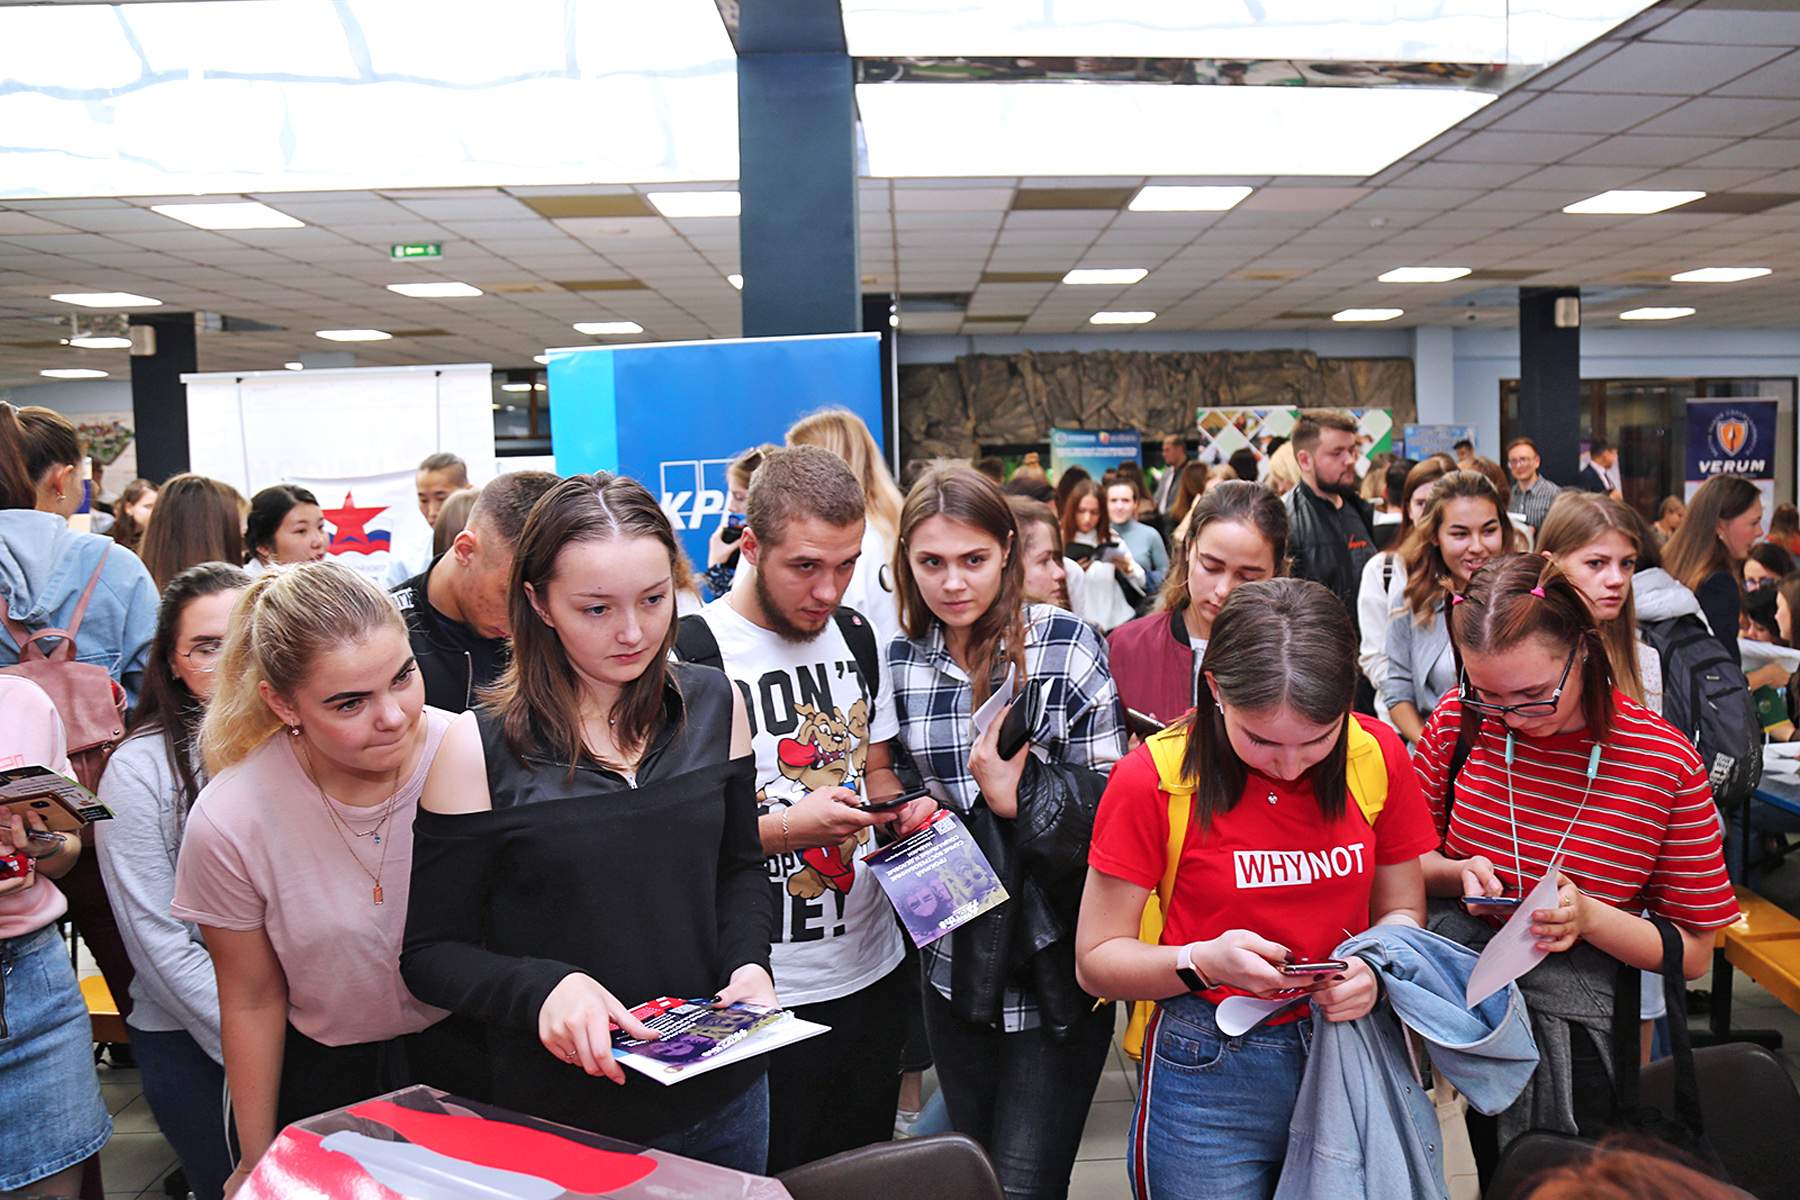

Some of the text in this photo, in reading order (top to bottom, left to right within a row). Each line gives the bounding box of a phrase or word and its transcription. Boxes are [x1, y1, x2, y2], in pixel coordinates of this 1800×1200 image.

[1698, 459, 1766, 473] VERUM
[662, 489, 731, 529] KP
[1238, 843, 1365, 884] WHY NOT
